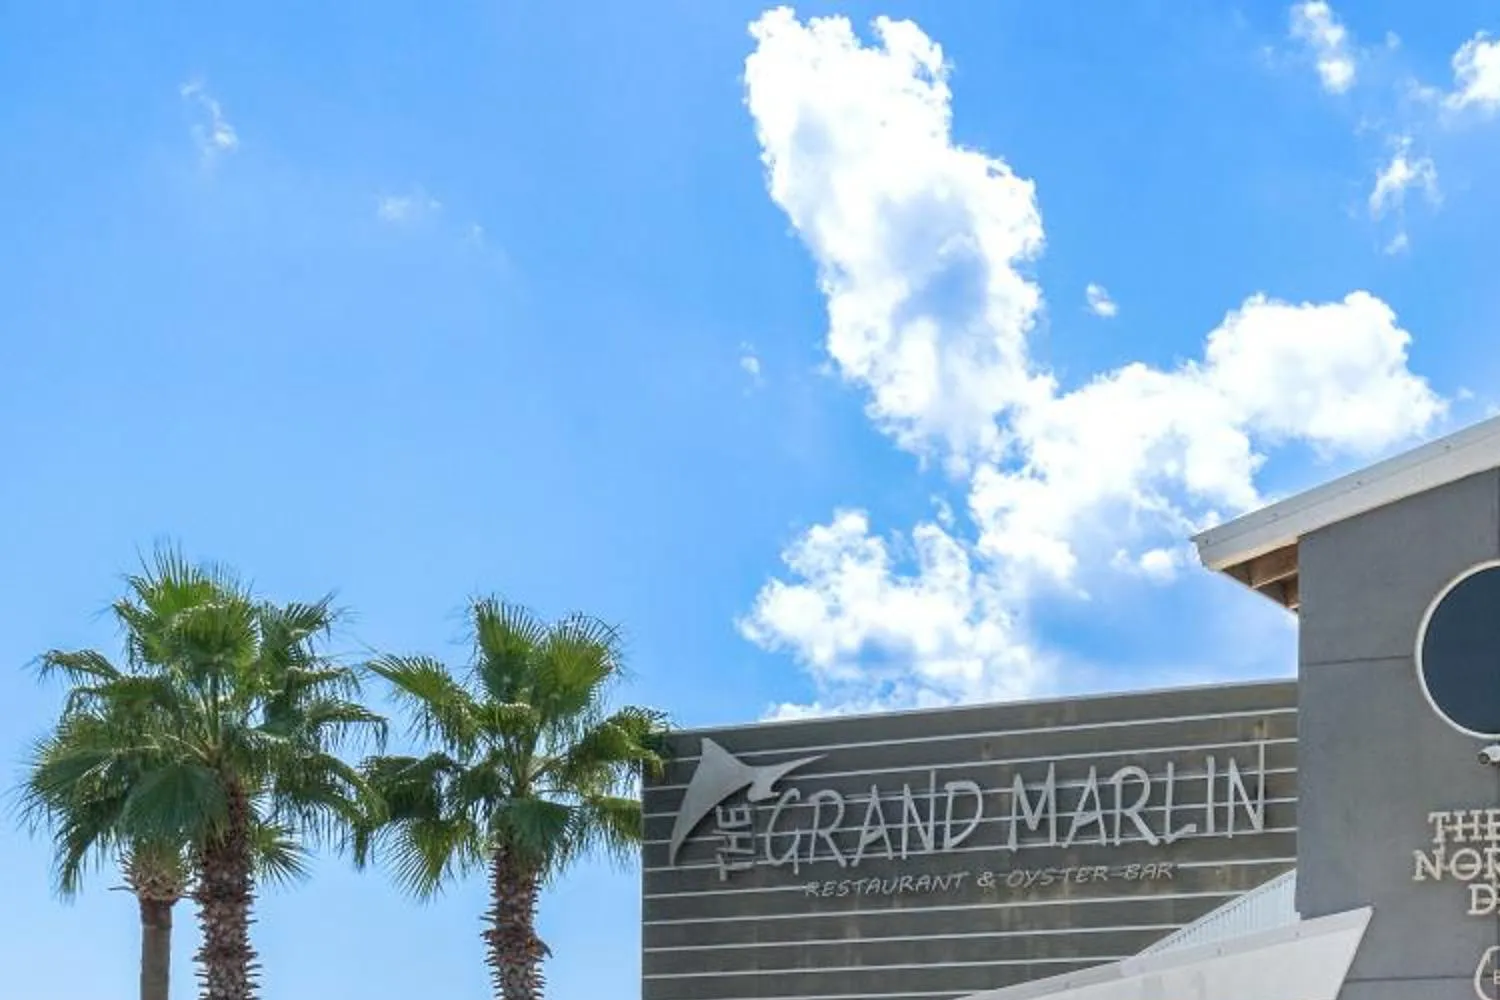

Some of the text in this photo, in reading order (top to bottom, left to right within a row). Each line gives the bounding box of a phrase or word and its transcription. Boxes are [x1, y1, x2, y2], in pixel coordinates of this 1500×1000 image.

[711, 742, 1266, 882] THE GRAND MARLIN
[803, 863, 1175, 898] RESTAURANT & OYSTER BAR
